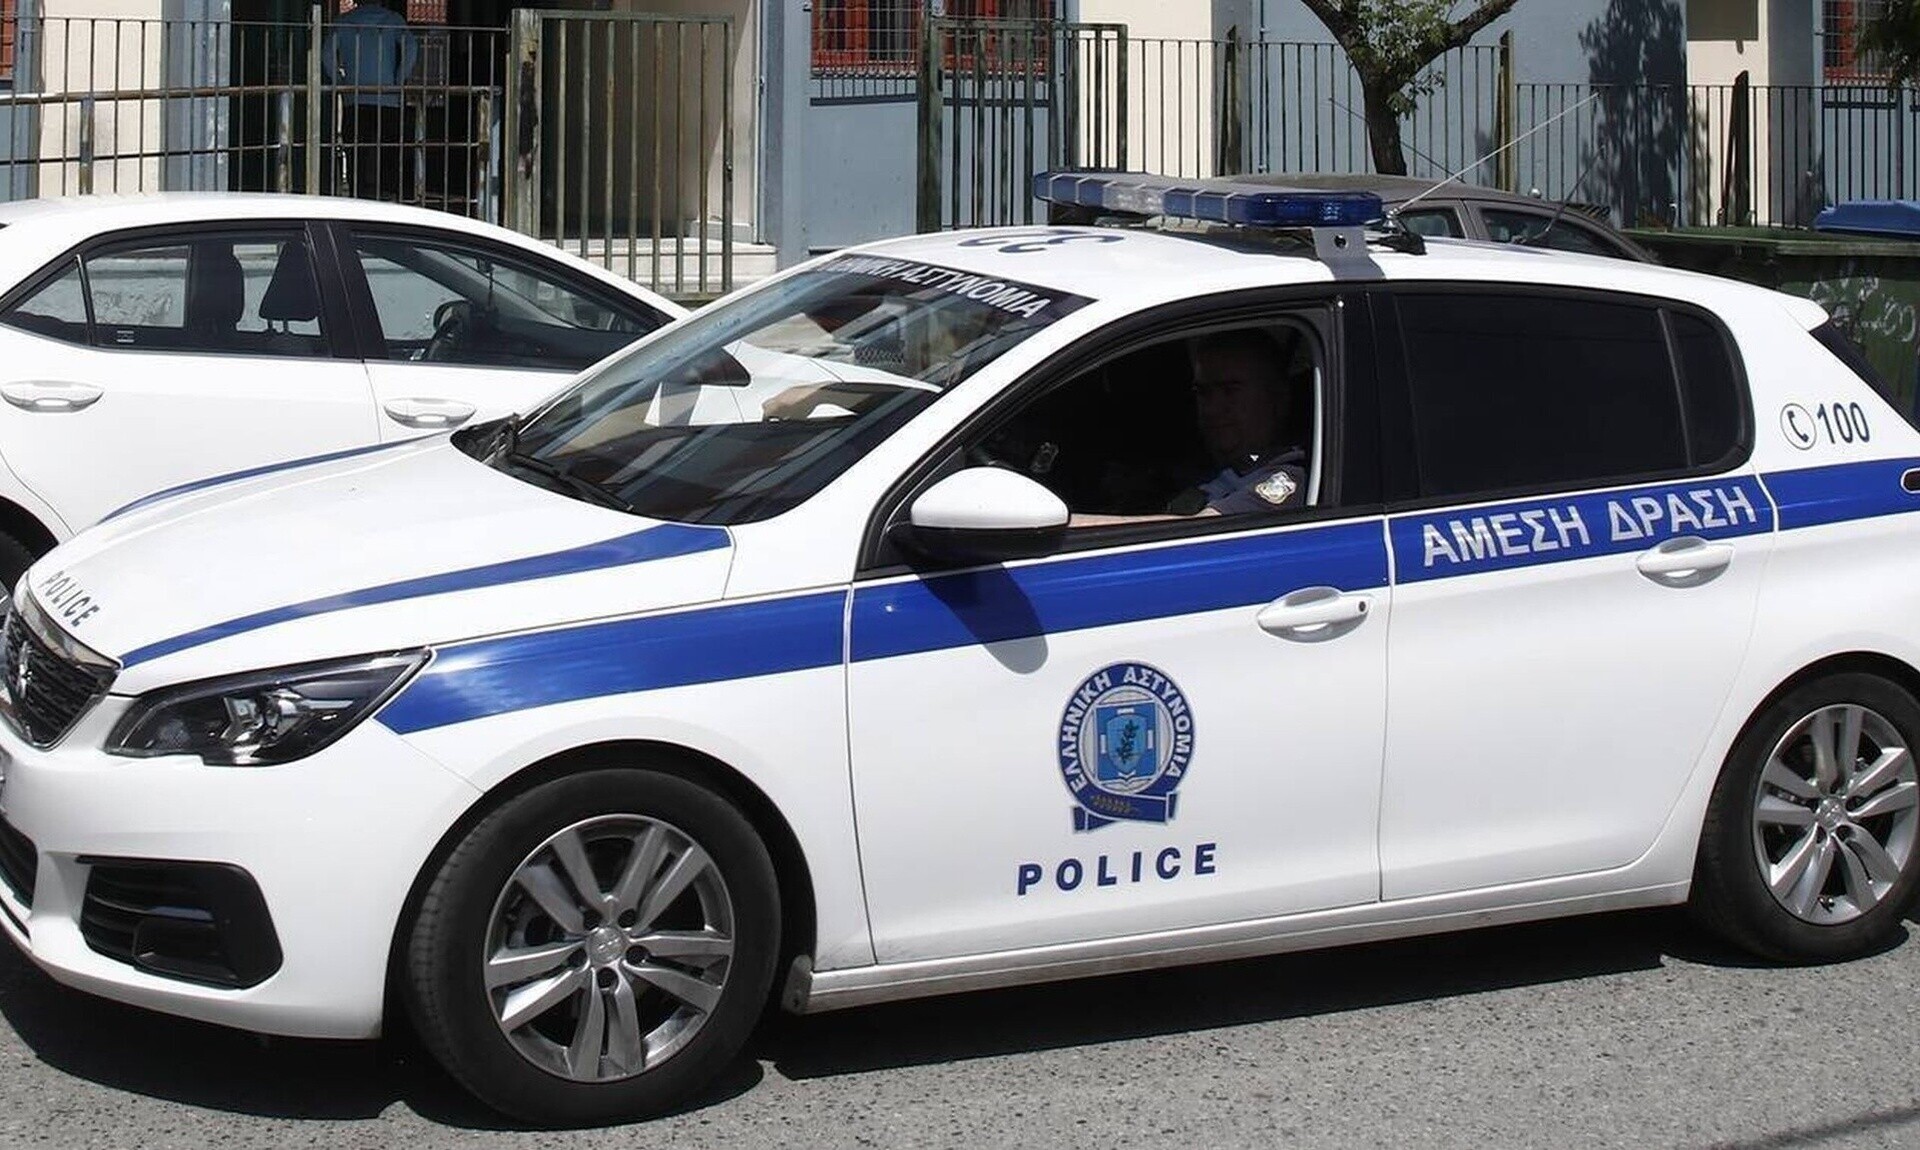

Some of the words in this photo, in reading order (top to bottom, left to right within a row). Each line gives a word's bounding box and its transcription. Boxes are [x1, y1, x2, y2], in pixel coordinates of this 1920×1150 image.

[1816, 402, 1871, 444] 100
[1422, 506, 1591, 567] ΑΜΕΣΗ
[1608, 486, 1757, 543] ΔΡΑΣΗ
[39, 569, 100, 628] POLICE
[1062, 672, 1112, 793] ΕΛΛΗΝΙΚΗ
[1123, 666, 1192, 780] ΑΣΤΥΝΟΜΙΑ
[1017, 843, 1216, 896] POLICE
